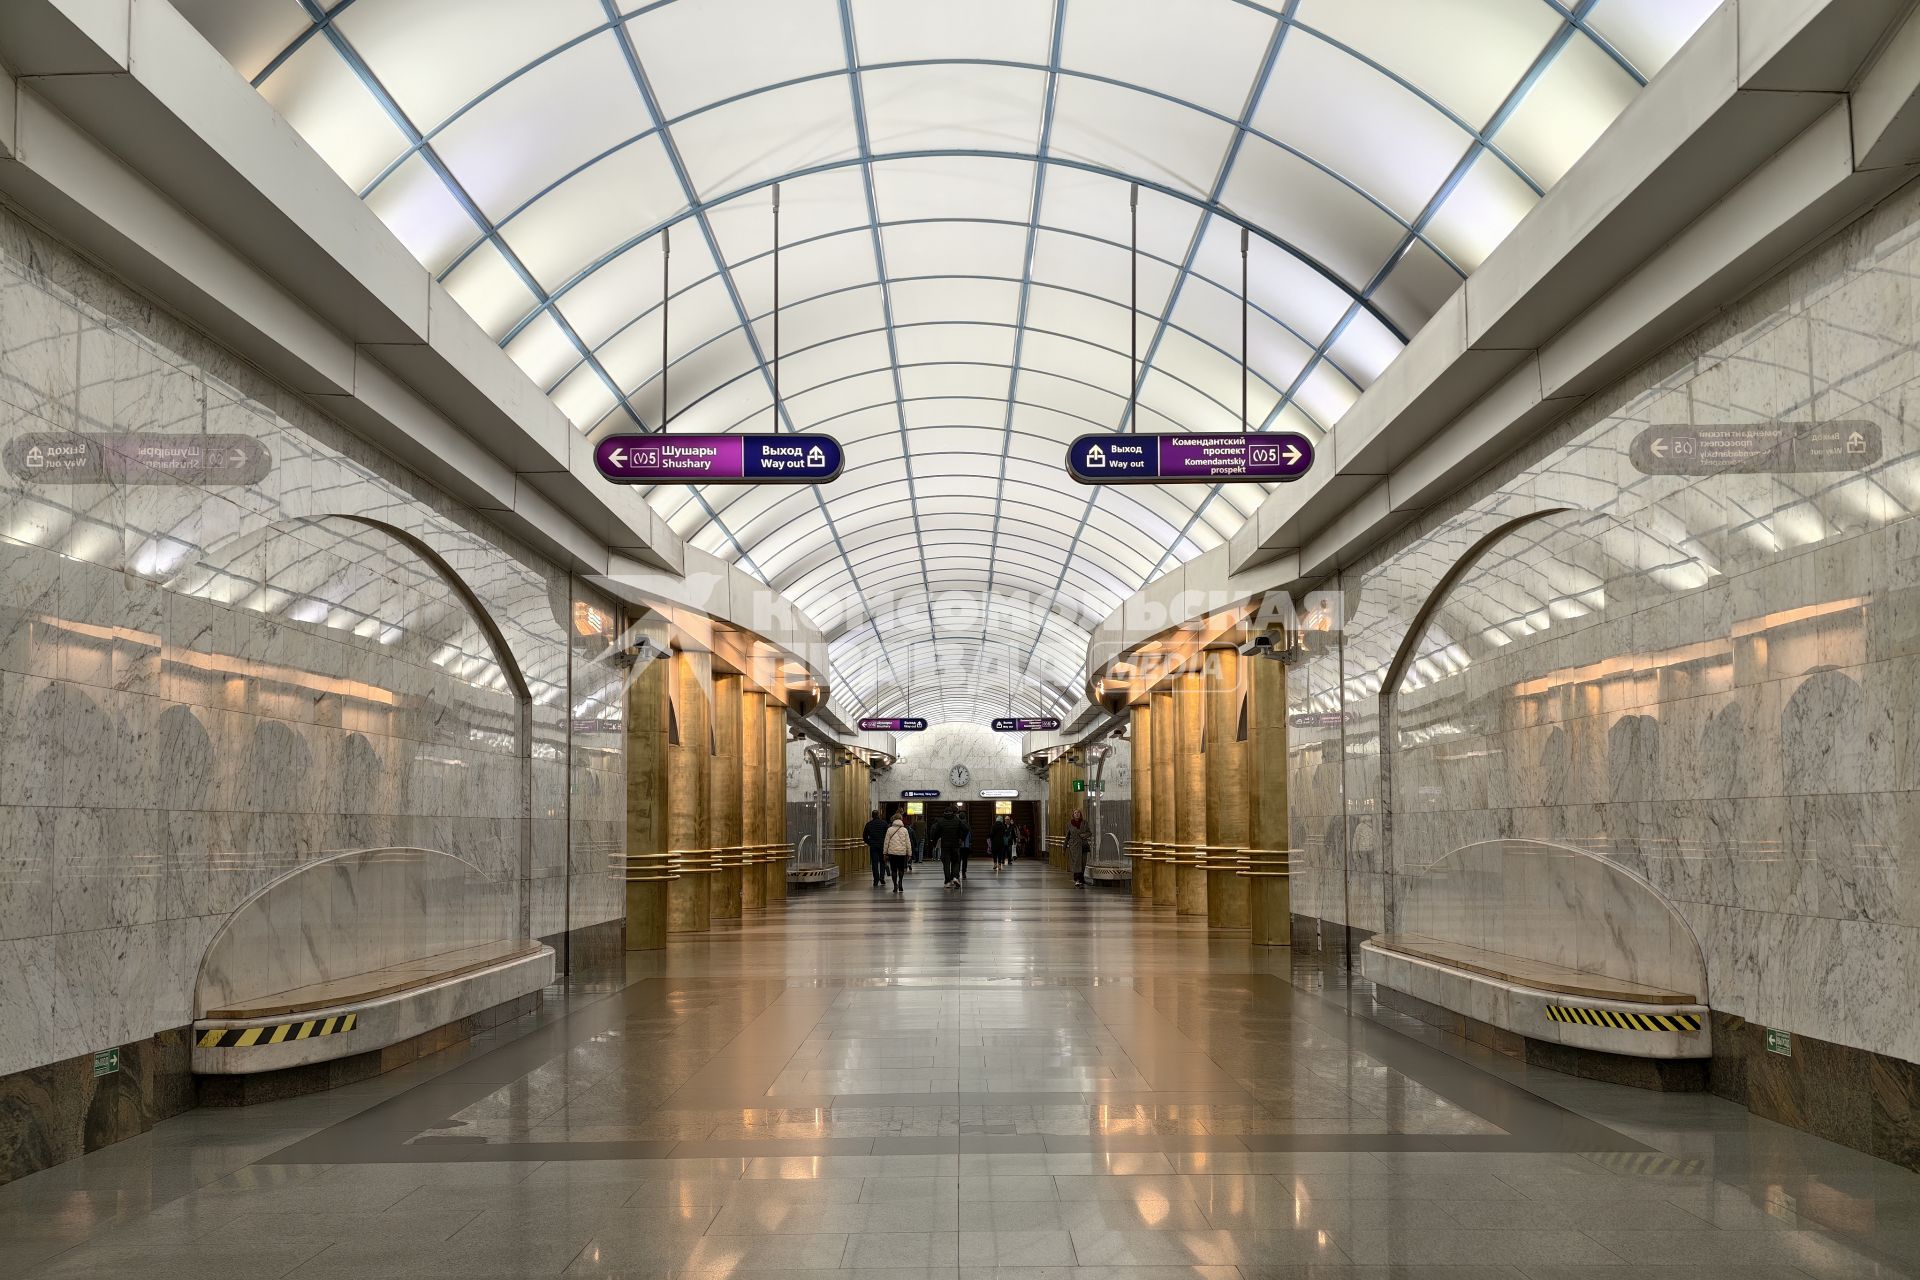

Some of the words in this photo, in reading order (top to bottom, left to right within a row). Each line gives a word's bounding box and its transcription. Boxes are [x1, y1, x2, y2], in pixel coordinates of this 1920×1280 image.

[1172, 437, 1246, 447] Комендантский
[662, 445, 717, 458] Шушары
[762, 445, 803, 458] Выход
[1111, 445, 1143, 455] Выход
[1203, 447, 1246, 457] проспект
[662, 458, 712, 470] Shushary
[761, 459, 783, 470] Way
[787, 459, 805, 468] out
[1109, 460, 1128, 469] Way
[1130, 460, 1145, 468] out
[1184, 458, 1246, 467] Komendantskiy
[1210, 466, 1246, 475] prospekt
